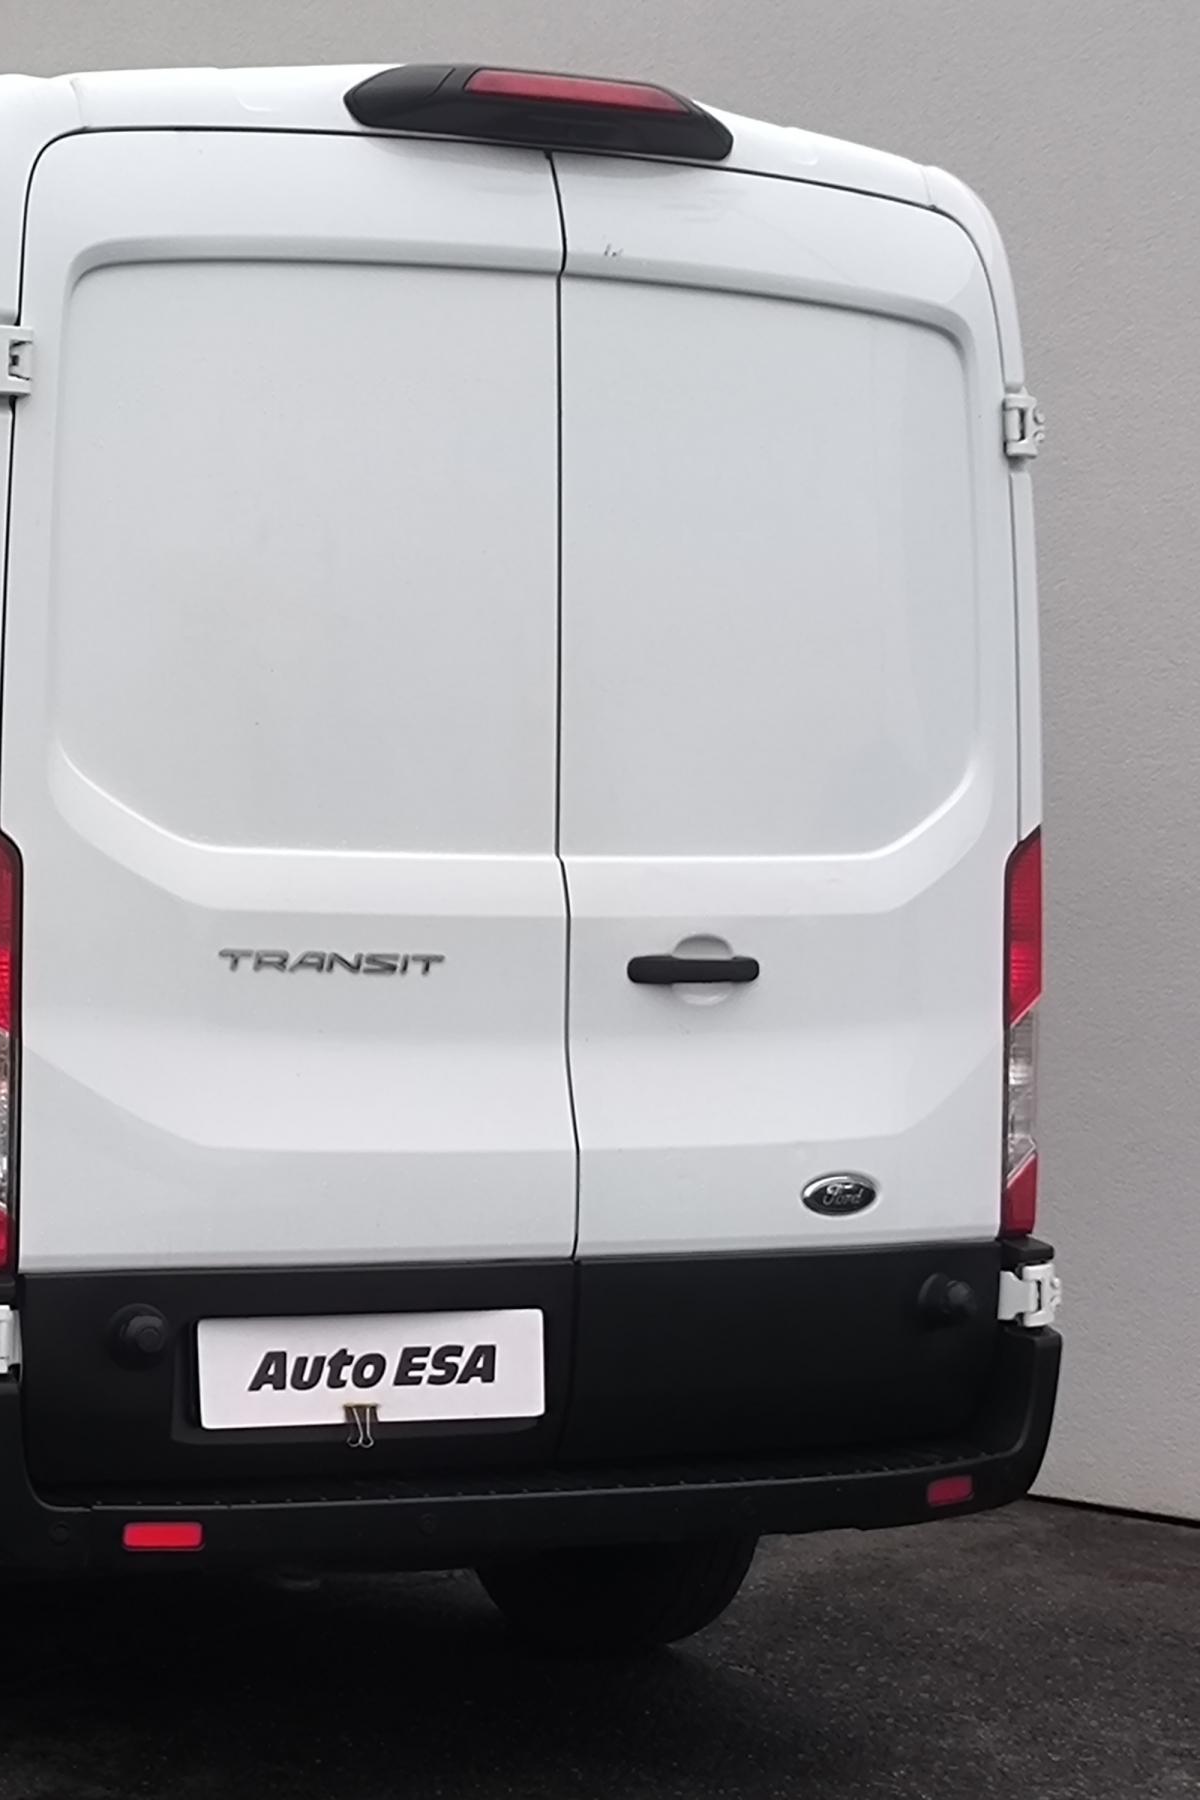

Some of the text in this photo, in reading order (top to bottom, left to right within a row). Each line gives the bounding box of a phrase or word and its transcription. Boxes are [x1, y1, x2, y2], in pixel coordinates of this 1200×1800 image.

[218, 948, 445, 975] TRANSIT
[248, 1344, 497, 1391] Auto ESA
